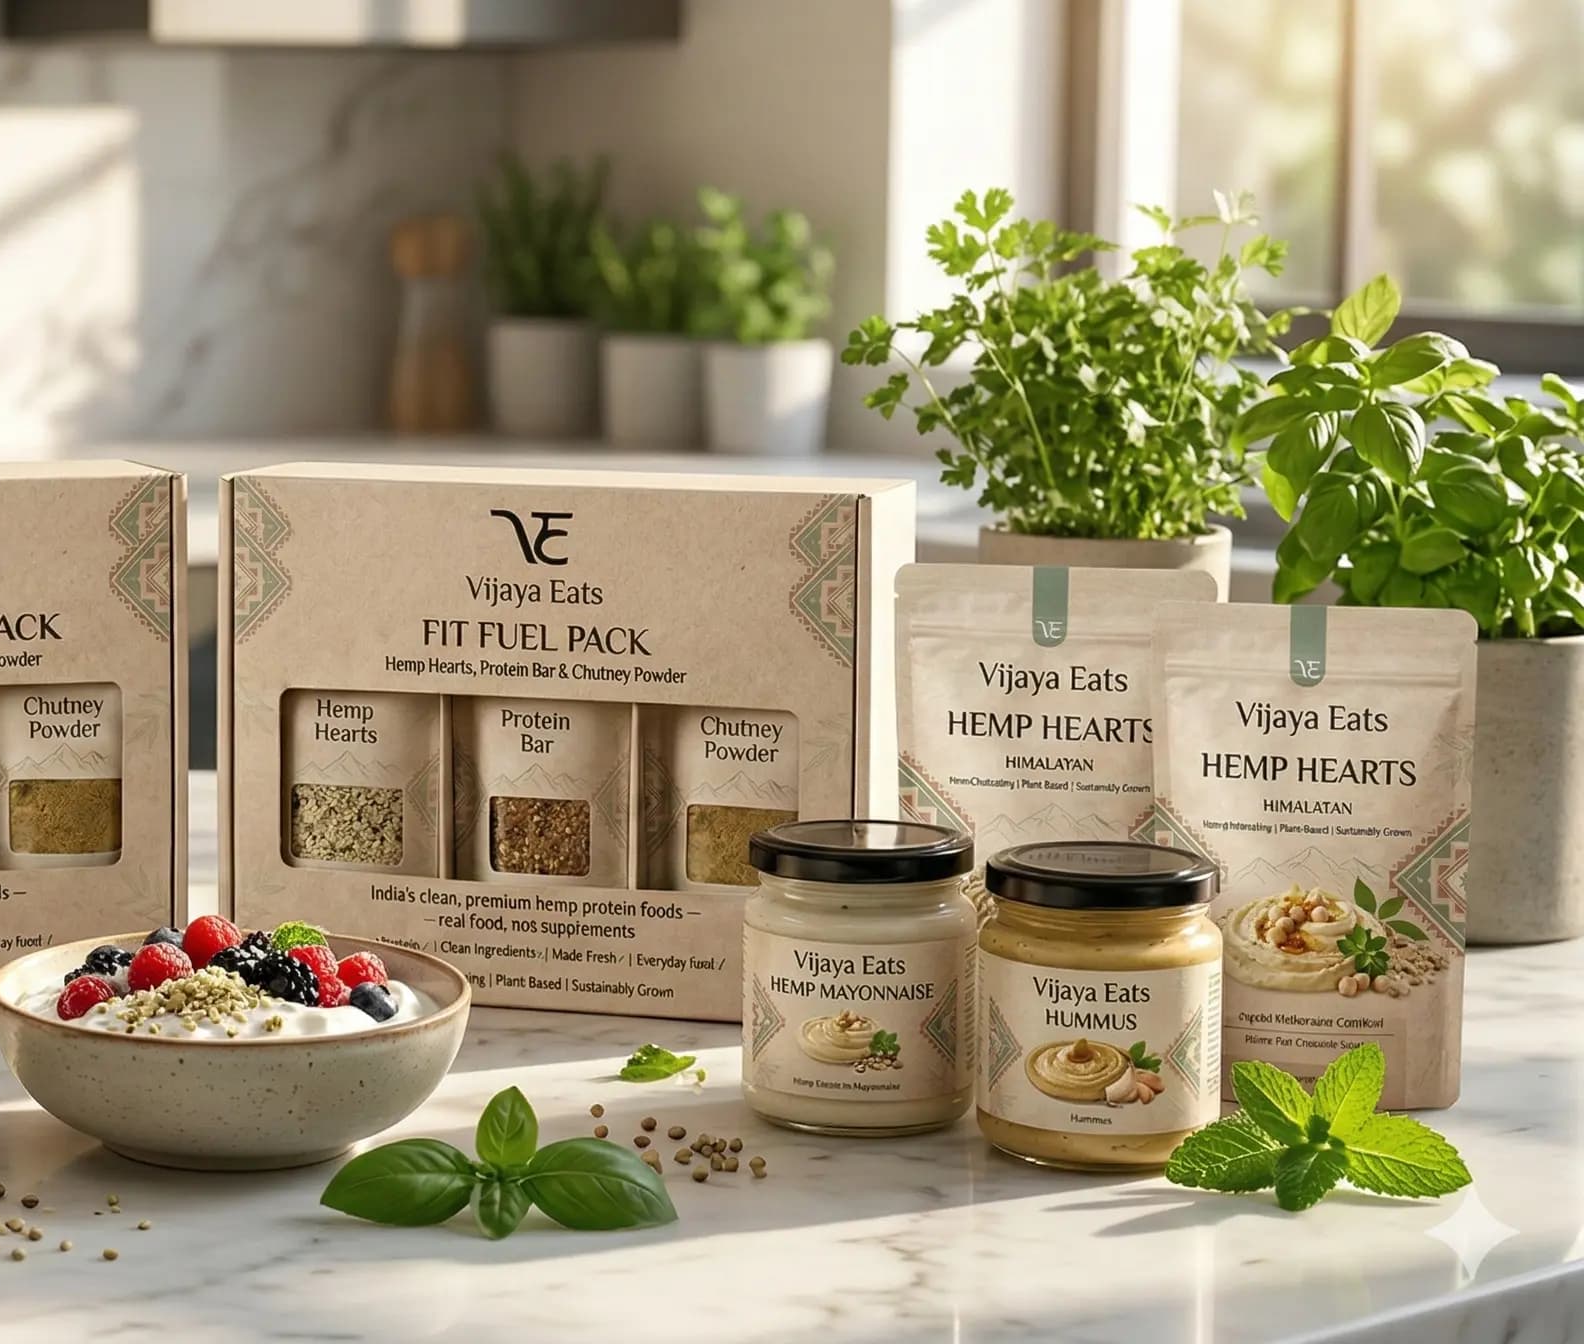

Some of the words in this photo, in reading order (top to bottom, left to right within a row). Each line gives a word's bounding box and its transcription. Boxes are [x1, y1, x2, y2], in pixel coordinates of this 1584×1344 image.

[465, 575, 543, 608] Vijaya
[549, 579, 604, 606] Eats
[422, 618, 470, 648] FIT
[477, 621, 559, 653] FUEL
[567, 625, 652, 657] PACK
[385, 655, 426, 676] Hemp
[428, 657, 477, 678] Hearts,
[480, 660, 529, 679] Protein
[532, 662, 557, 679] Bar
[558, 663, 569, 679] &
[571, 663, 631, 686] Chutney
[634, 667, 687, 684] Powder
[978, 661, 1060, 697] Vijaya
[1069, 665, 1129, 693] Eats
[22, 696, 105, 719] Chutney
[316, 698, 375, 722] Hemp
[501, 709, 571, 732] Protein
[1235, 700, 1320, 737] Vijaya
[1328, 705, 1389, 733] Eats
[28, 719, 101, 740] Powder
[314, 723, 378, 745] Hearts
[700, 716, 784, 743] Chutney
[947, 710, 1033, 739] HEMP
[1041, 714, 1153, 744] HEARTS
[521, 734, 555, 755] Bar
[704, 741, 780, 764] Powder
[1005, 755, 1095, 772] HIMALAYAN
[1201, 752, 1289, 782] HEMP
[1296, 756, 1417, 787] HEARTS
[419, 888, 462, 908] clean,
[465, 894, 532, 912] premium
[535, 895, 579, 917] hemp
[582, 898, 637, 919] protein
[640, 900, 683, 920] foods
[438, 913, 466, 929] real
[469, 914, 508, 933] food,
[440, 940, 472, 955] Clean
[473, 942, 537, 960] Ingredients
[552, 948, 583, 963] Made
[586, 950, 617, 964] Fresh
[635, 953, 686, 972] Everyday
[793, 950, 856, 979] Vijaya
[862, 955, 906, 976] Eats
[495, 973, 526, 988] Plant
[528, 976, 562, 991] Based
[571, 978, 635, 998] Sustainably
[770, 975, 816, 998] HEMP
[819, 982, 935, 1001] MAYONNAISE
[1032, 976, 1097, 1007] Vijaya
[1103, 982, 1151, 1004] Eats
[1045, 1008, 1138, 1031] HUMMUS
